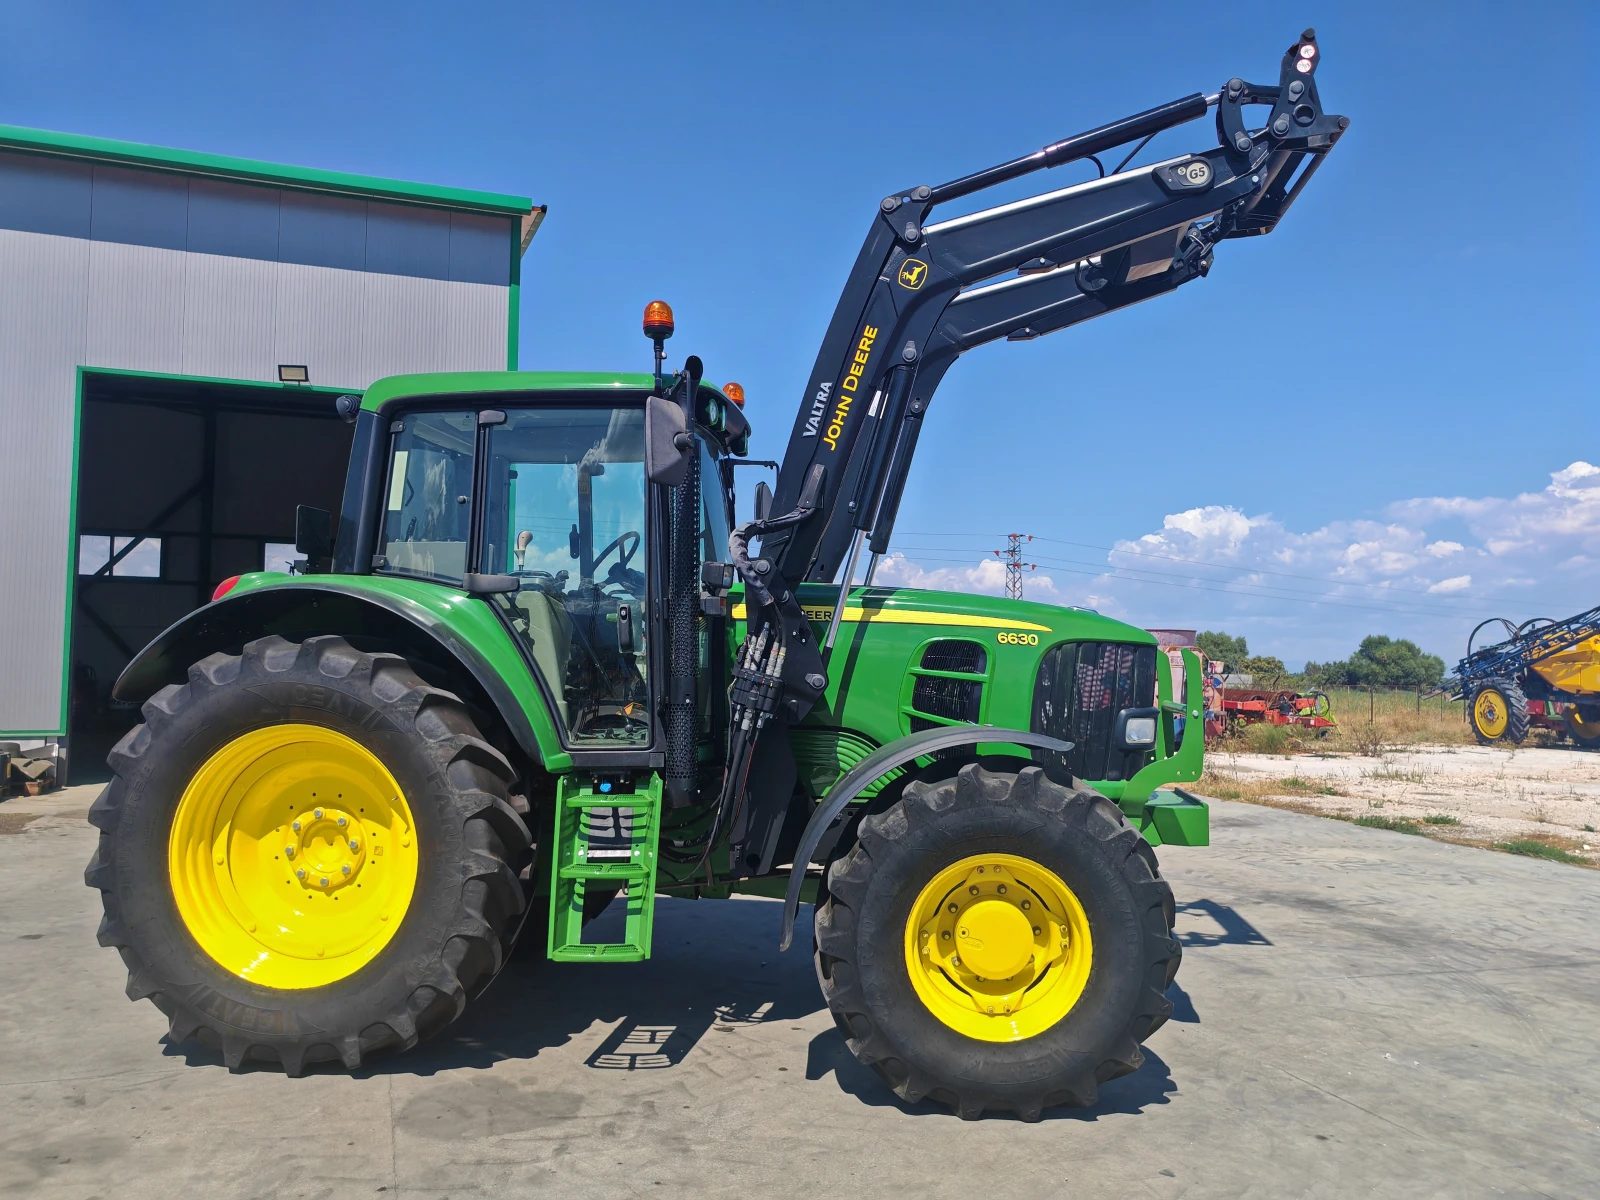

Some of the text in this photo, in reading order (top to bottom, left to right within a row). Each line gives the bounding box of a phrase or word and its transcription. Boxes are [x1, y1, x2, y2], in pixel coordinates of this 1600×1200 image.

[1189, 167, 1205, 179] G5
[823, 325, 878, 451] JOHN DEERE
[802, 382, 833, 438] VALTRA
[801, 609, 832, 620] EER
[997, 631, 1039, 646] 6630
[292, 684, 361, 718] CEAT
[205, 996, 276, 1032] CEAT
